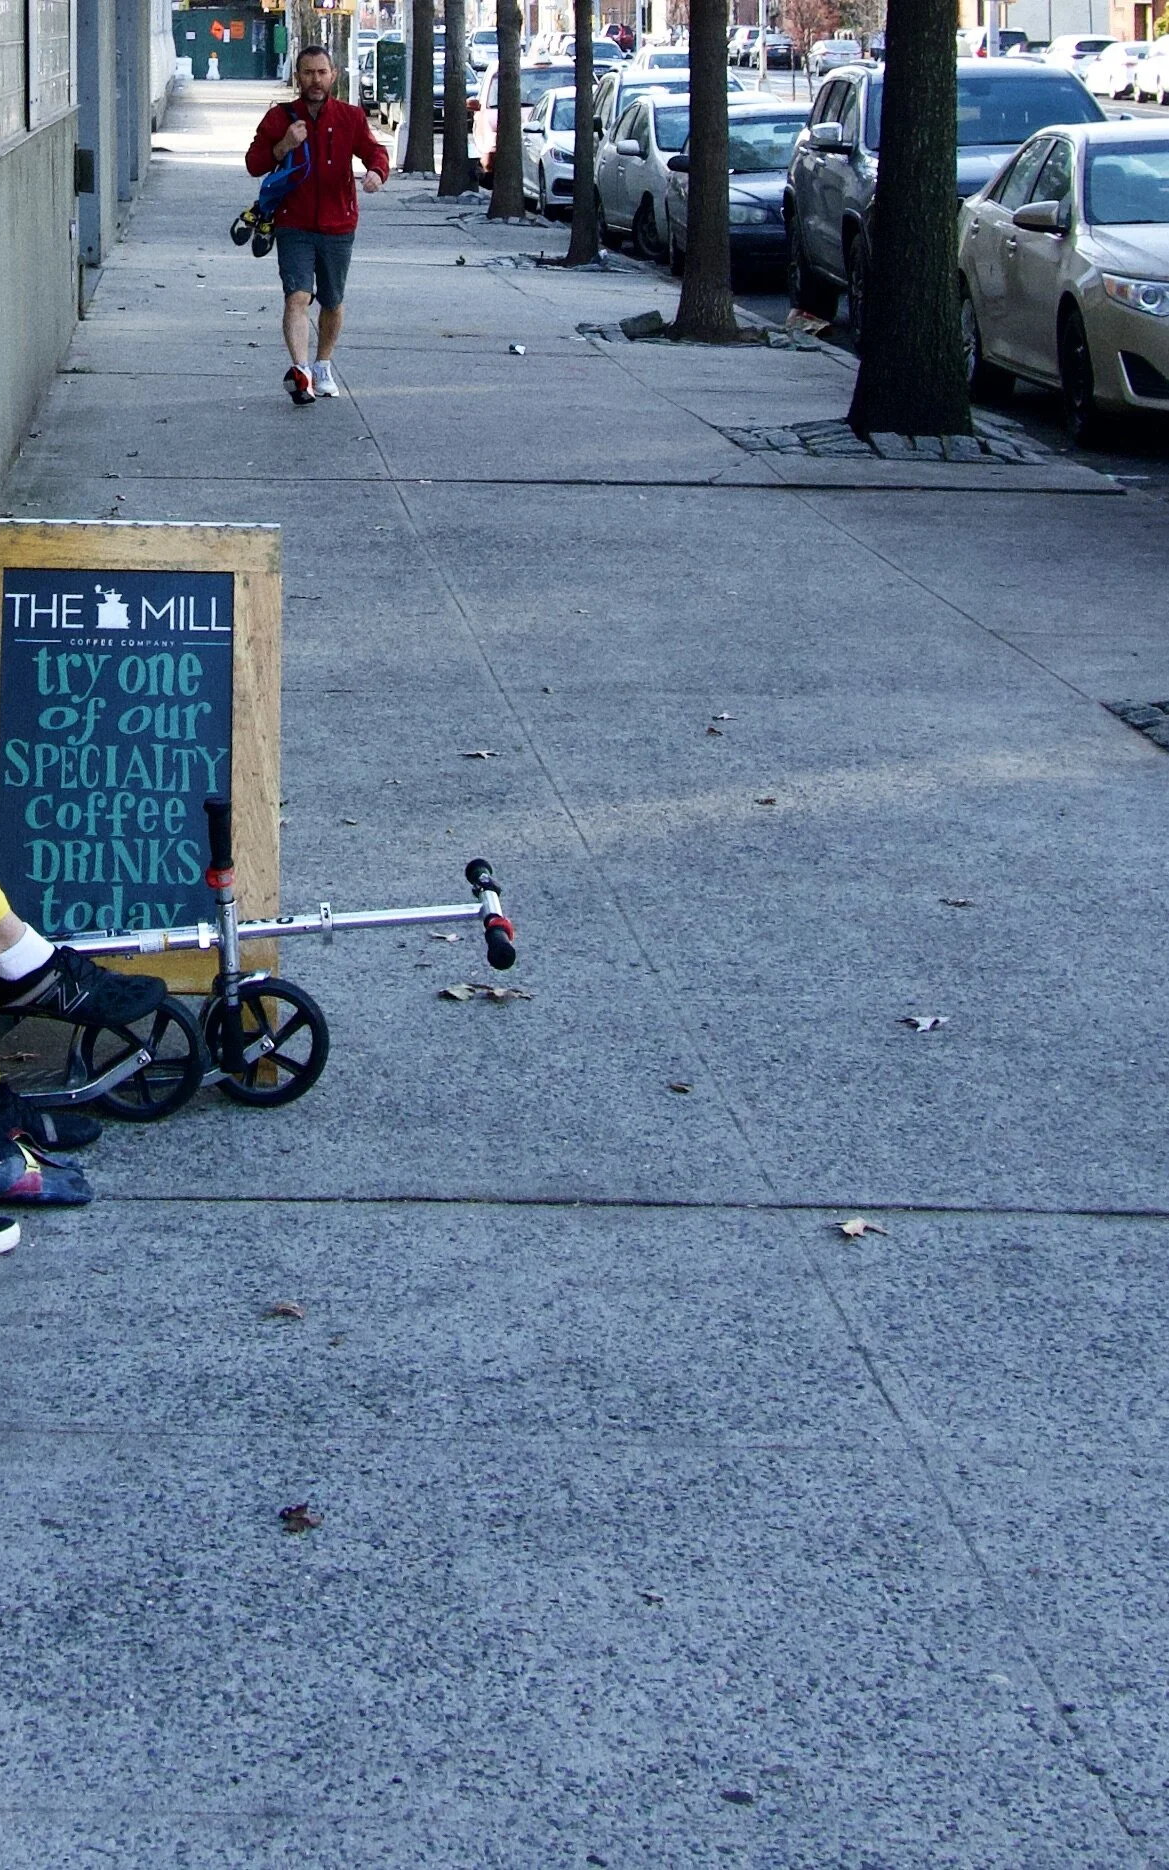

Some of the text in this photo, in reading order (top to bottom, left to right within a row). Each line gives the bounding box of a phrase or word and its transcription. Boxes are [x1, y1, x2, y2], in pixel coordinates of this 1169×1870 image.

[5, 593, 231, 631] THE MILL
[70, 638, 176, 648] COFFEE COMPANY
[32, 646, 203, 701] try one
[38, 697, 211, 744] of our
[4, 739, 229, 793] SPECIALTY
[24, 838, 201, 886] DRINKS
